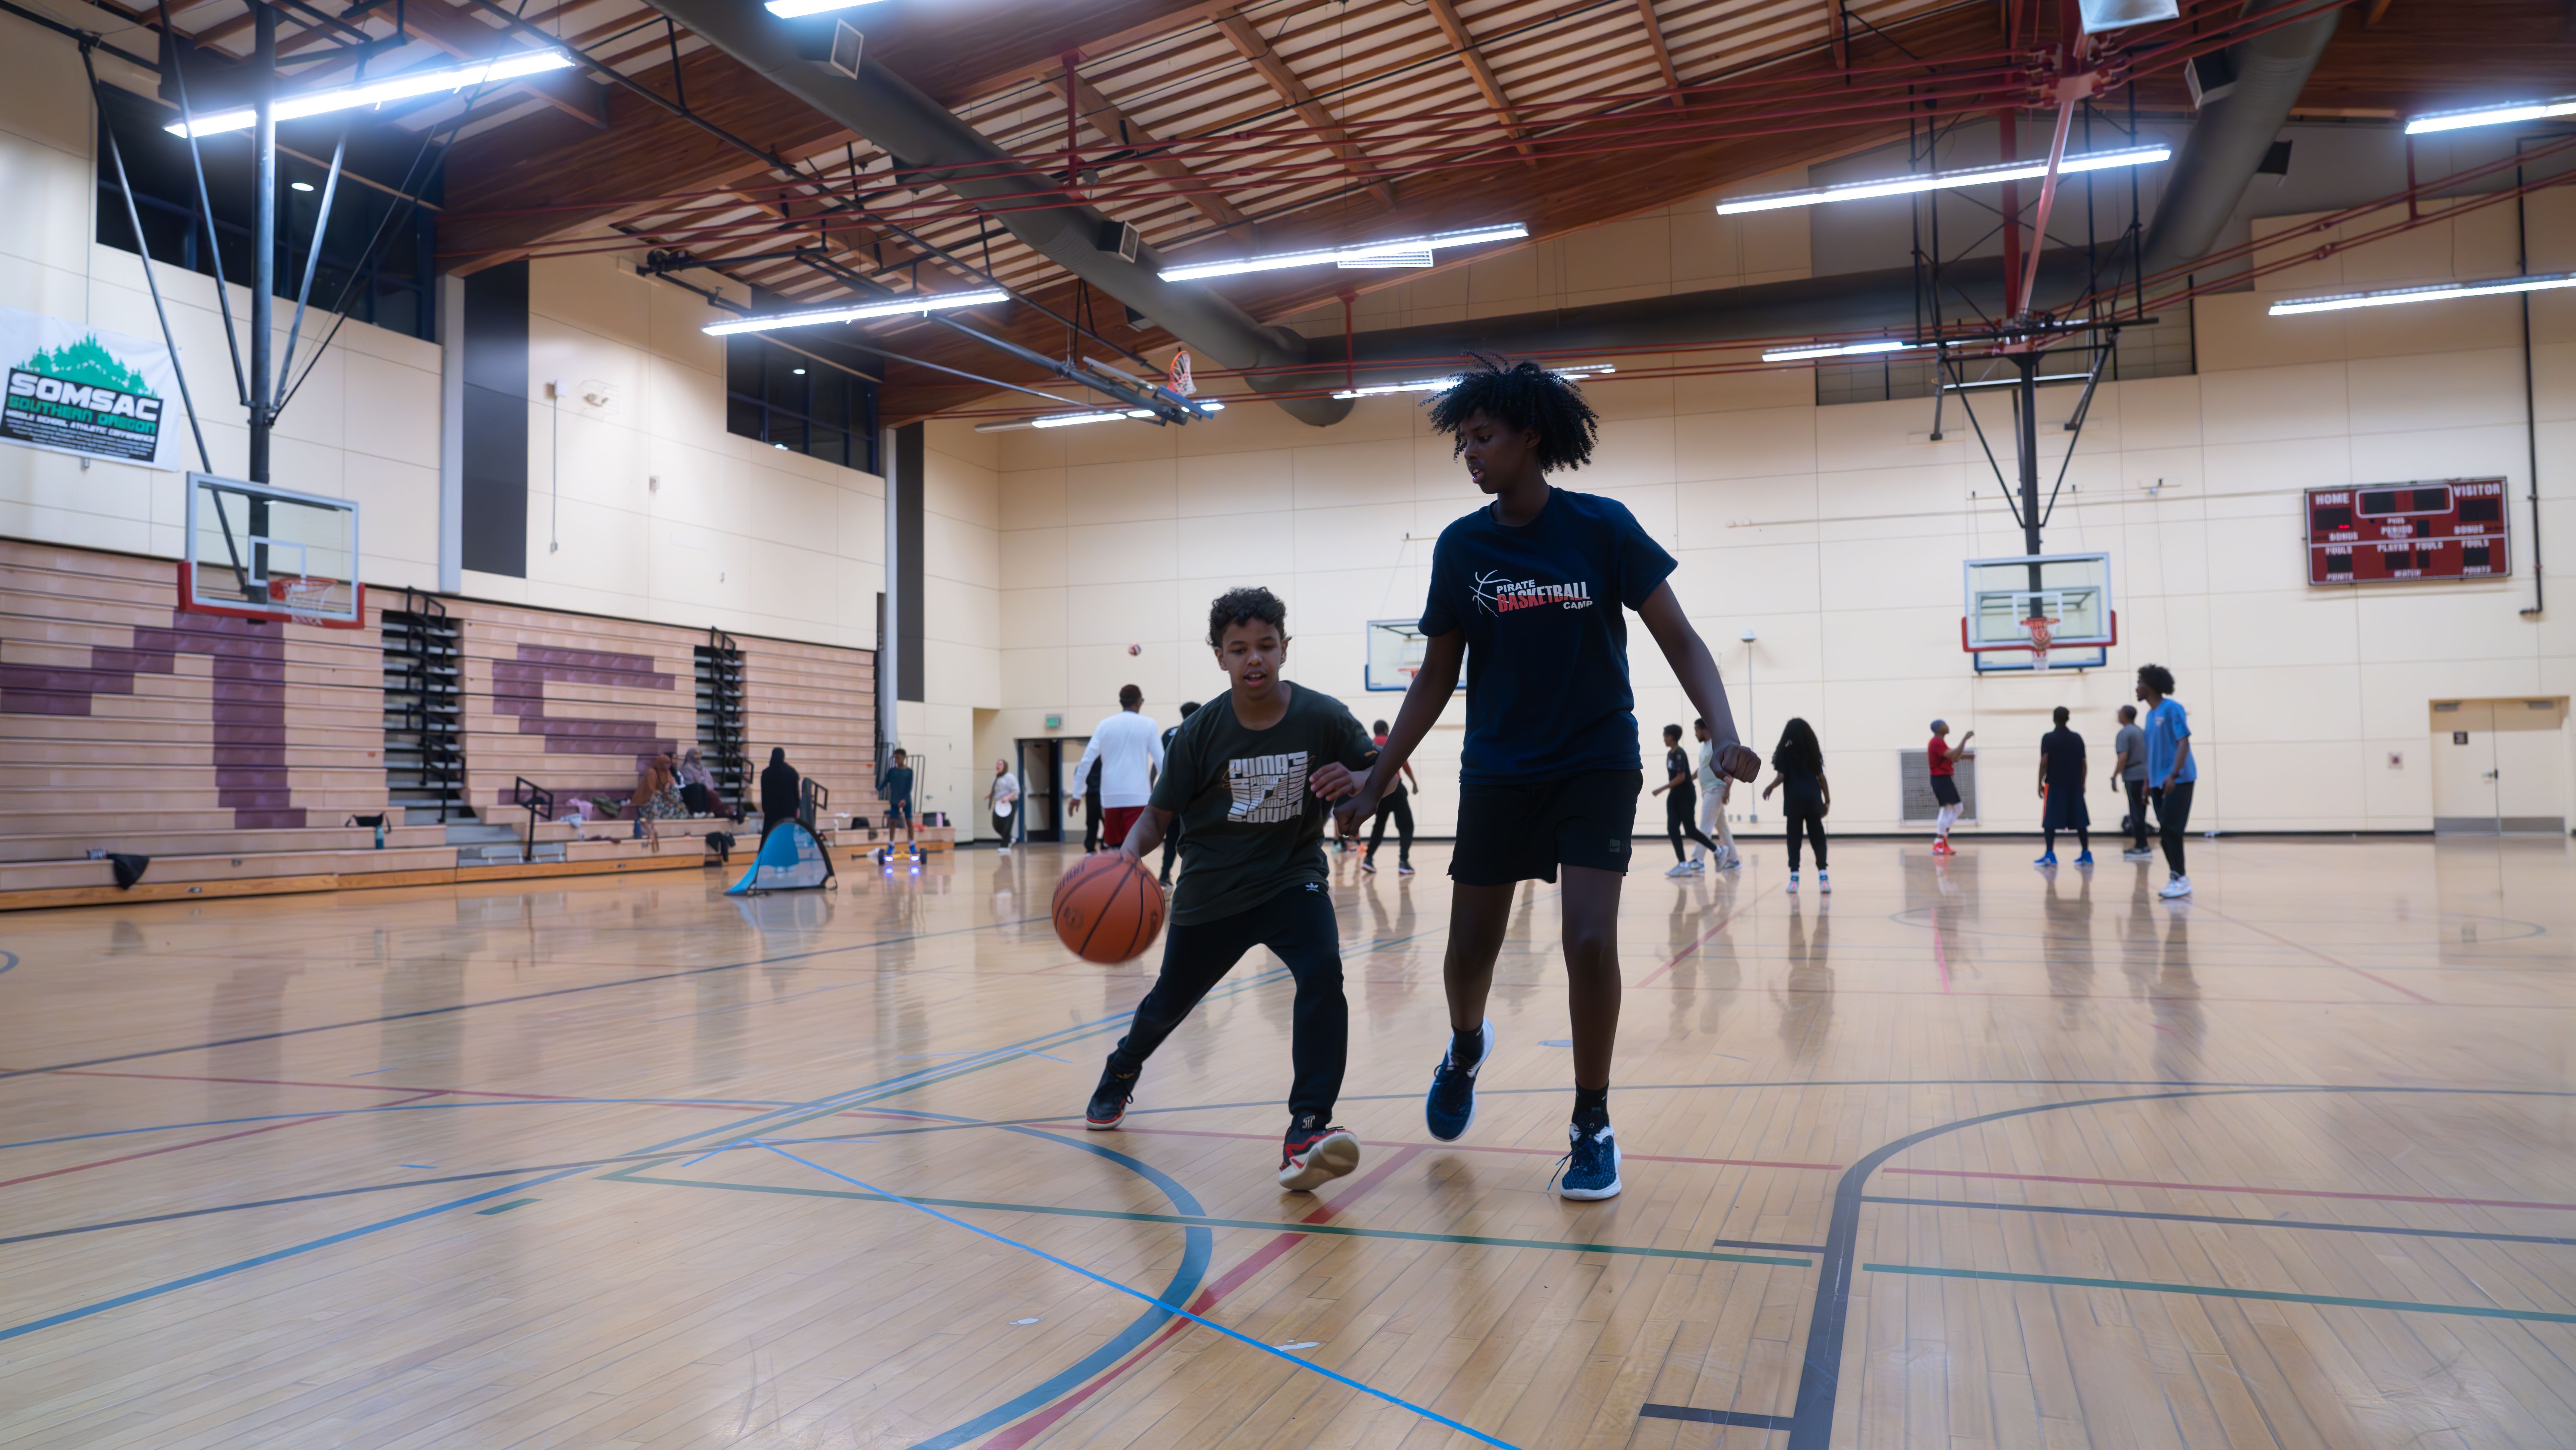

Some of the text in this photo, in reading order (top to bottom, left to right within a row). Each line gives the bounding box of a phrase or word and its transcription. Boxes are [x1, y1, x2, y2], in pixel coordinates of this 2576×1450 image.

[9, 372, 160, 422] SOMSAC
[7, 395, 157, 435] SOUTHERN OREGON
[36, 415, 68, 429] SCHOOL
[2454, 482, 2501, 497] VISITOR
[2315, 492, 2350, 505] HOME
[2380, 525, 2413, 536] PERIOD
[2454, 524, 2484, 535] BONUS
[2329, 531, 2358, 542] BONUS
[2461, 538, 2490, 548] FOULS
[2325, 546, 2353, 555] FOULS
[2377, 540, 2444, 553] PLAYER FOULS
[1496, 579, 1536, 594] PIRATE
[1497, 581, 1591, 613] BASKETBALL
[1563, 600, 1593, 610] CAMP
[1229, 754, 1289, 779] PUMA
